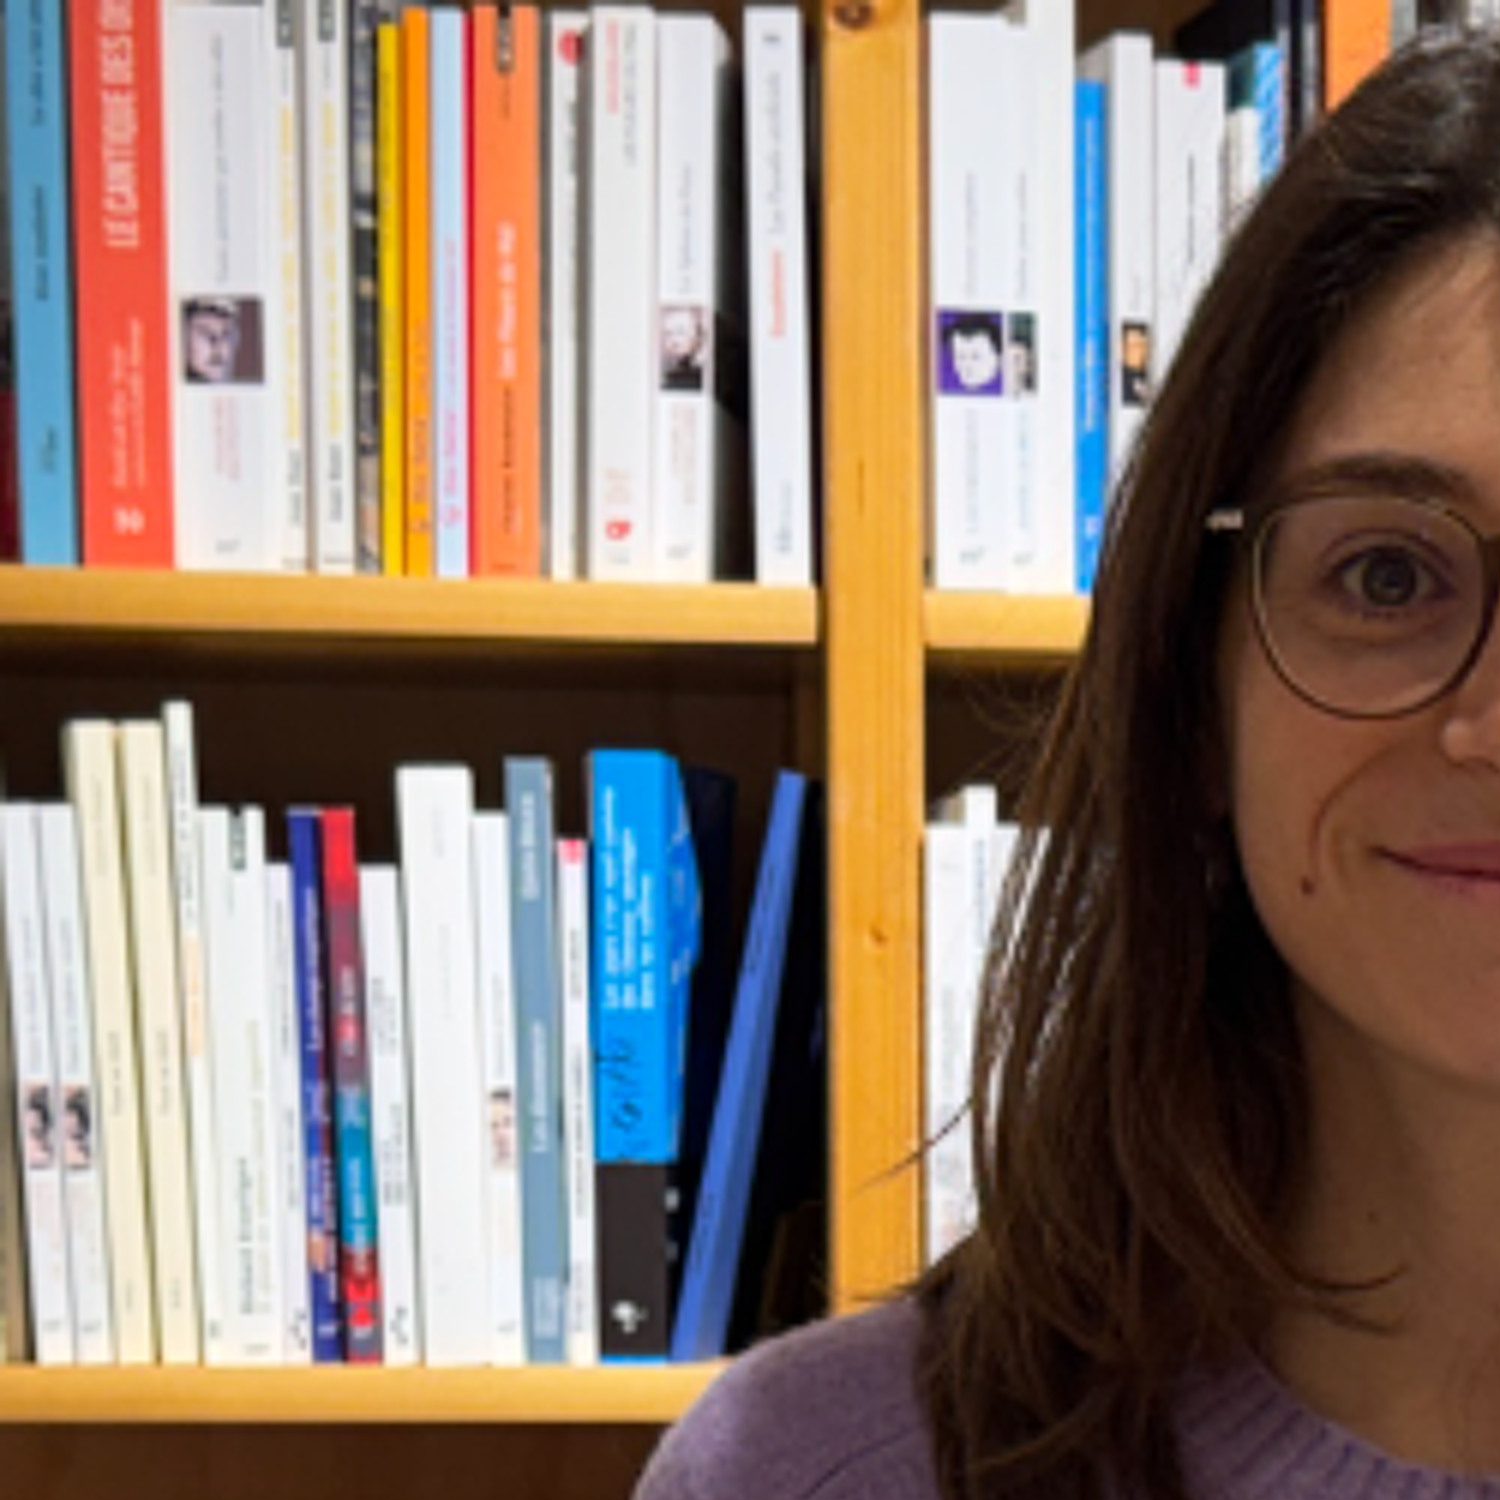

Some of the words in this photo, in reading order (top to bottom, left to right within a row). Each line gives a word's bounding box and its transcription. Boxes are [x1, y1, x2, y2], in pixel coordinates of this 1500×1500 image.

[98, 34, 134, 83] DES
[100, 88, 139, 212] CANTIQUE
[104, 216, 140, 248] LE
